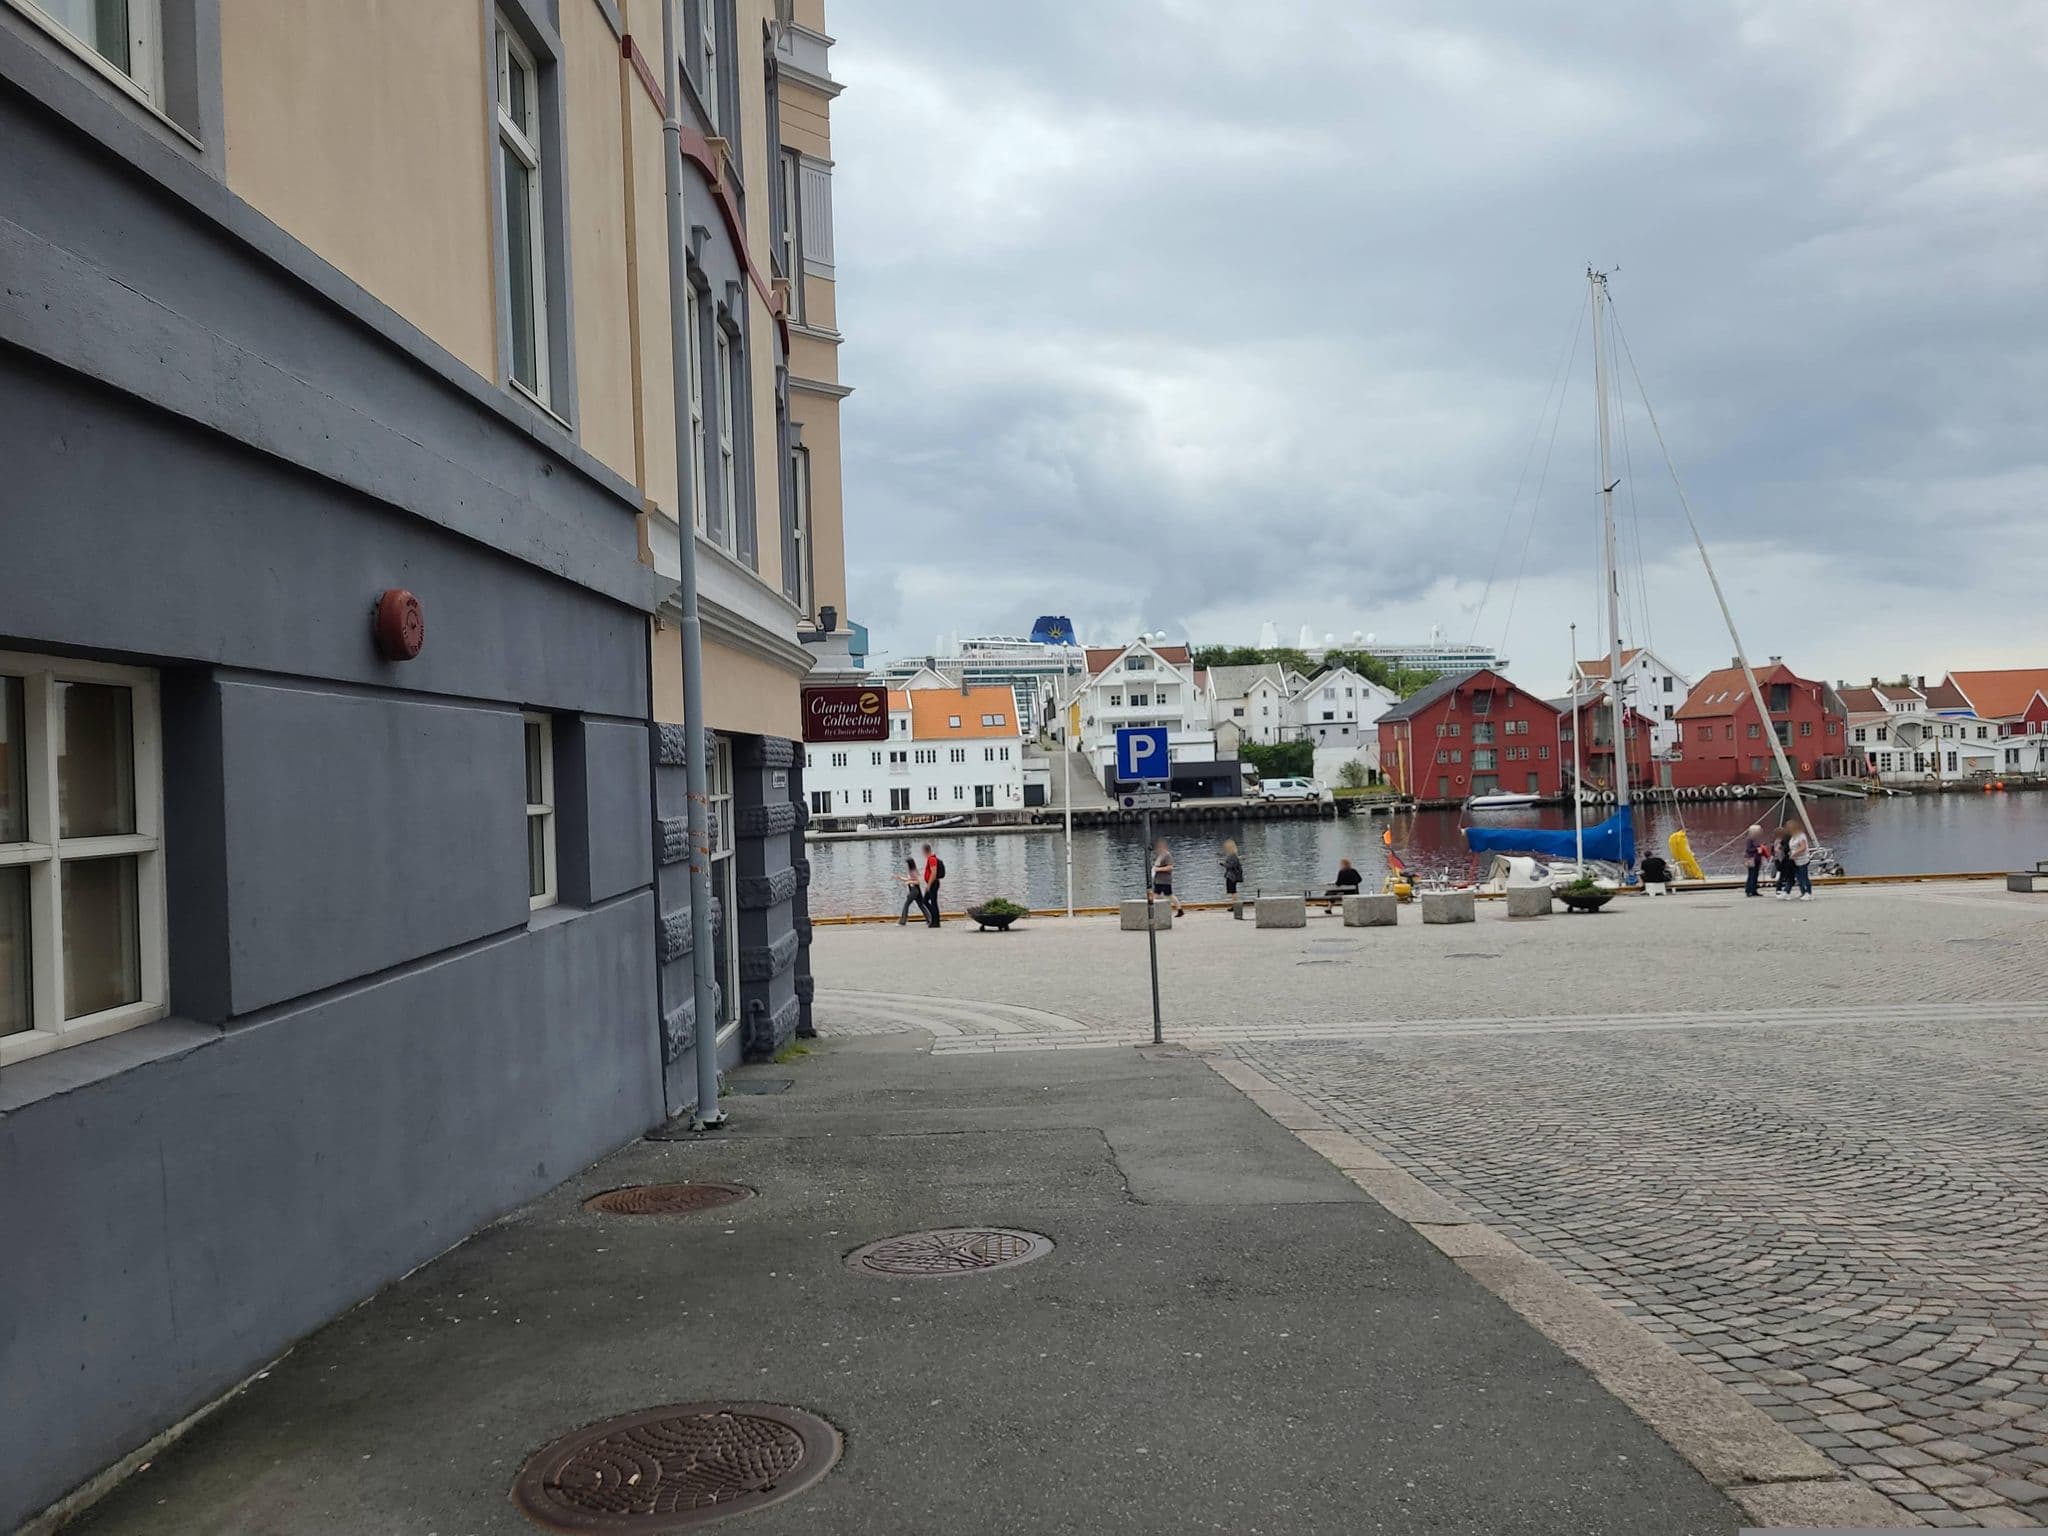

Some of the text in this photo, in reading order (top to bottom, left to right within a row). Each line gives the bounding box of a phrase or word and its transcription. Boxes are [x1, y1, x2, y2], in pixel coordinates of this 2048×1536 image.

[811, 696, 857, 715] Clarion
[823, 714, 880, 727] Collection
[1129, 734, 1156, 773] P
